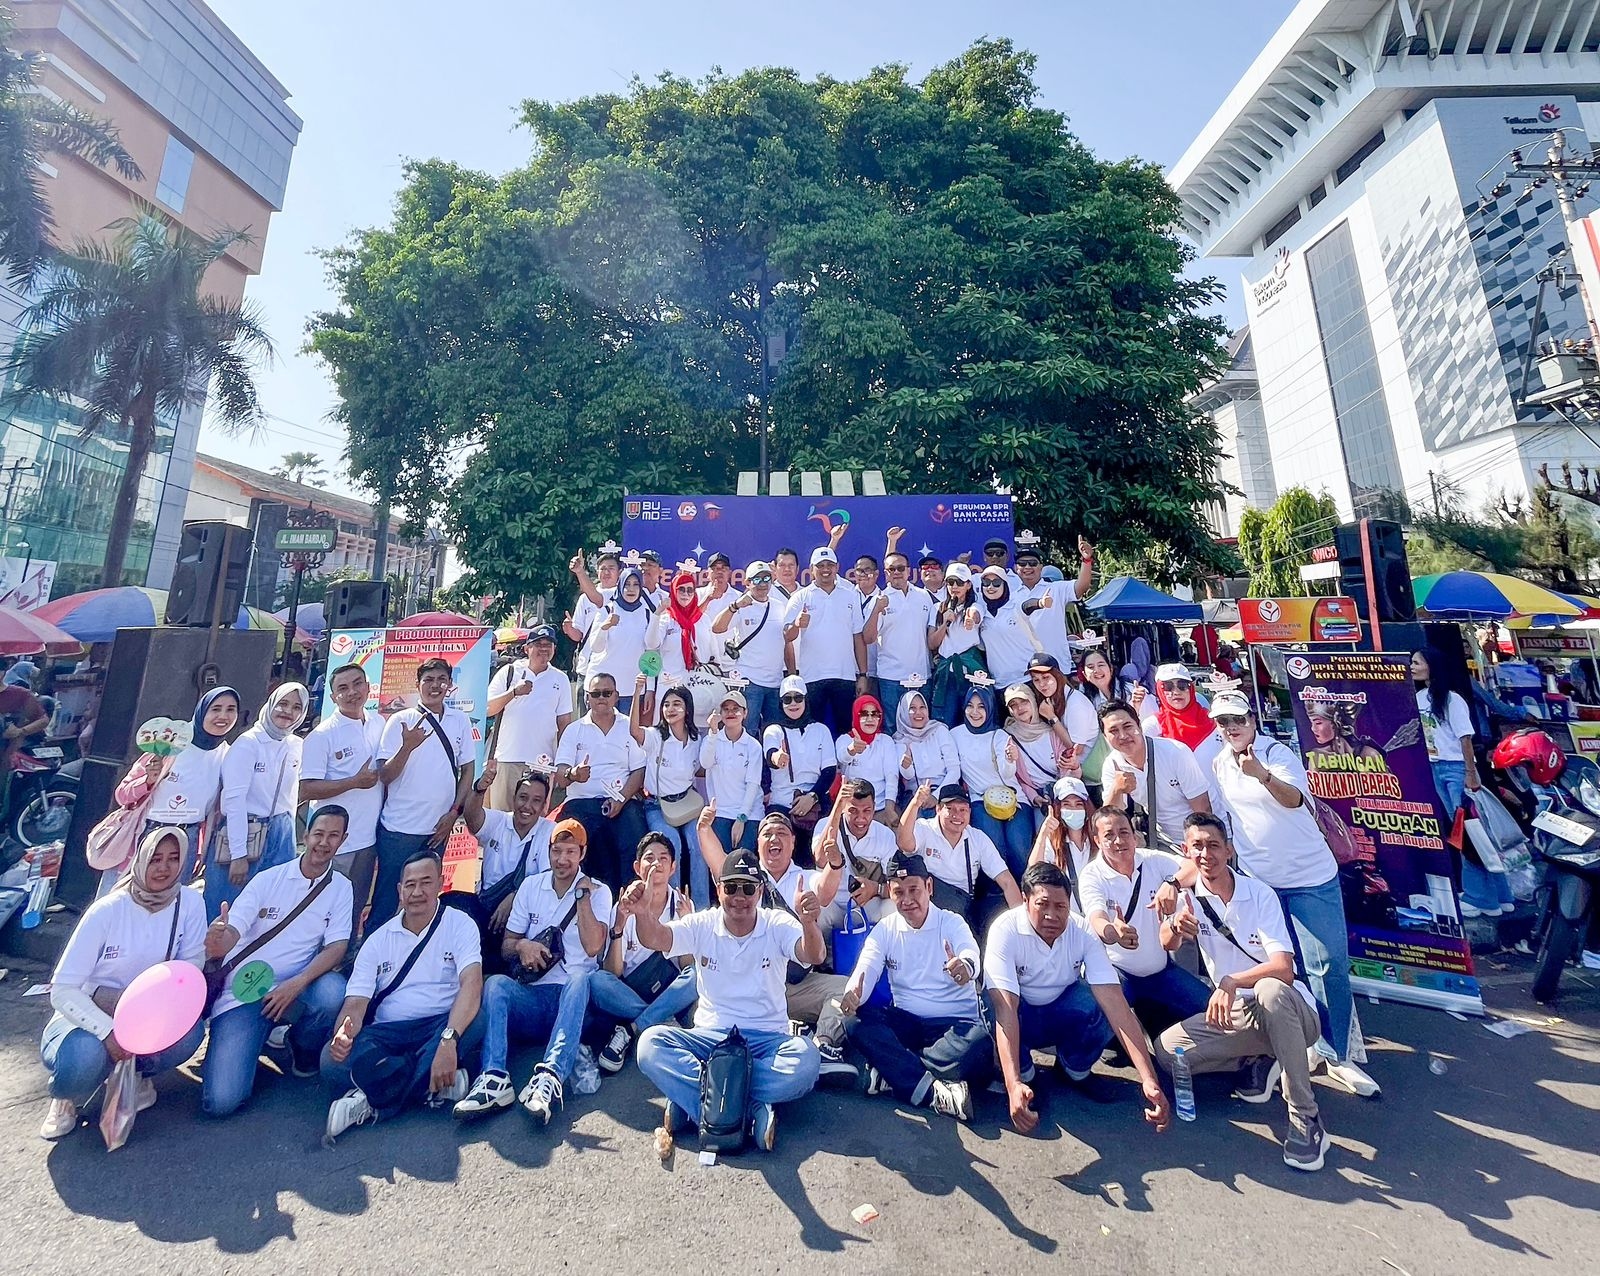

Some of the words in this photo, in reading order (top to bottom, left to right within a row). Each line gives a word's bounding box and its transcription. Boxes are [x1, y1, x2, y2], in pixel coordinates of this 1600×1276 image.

[1503, 116, 1538, 124] Telkom
[290, 533, 305, 544] IMAM
[395, 629, 441, 640] PRODUK
[442, 627, 482, 639] KREDIT
[1522, 638, 1566, 648] JASMINE
[386, 644, 418, 654] KREDIT
[1330, 655, 1382, 663] Perumda
[1370, 664, 1407, 672] PASAR
[1315, 672, 1343, 680] KOTA
[1346, 672, 1405, 681] SEMARANG
[1305, 751, 1387, 773] TABUNGAN
[1306, 770, 1361, 799] SRIKANDI
[1360, 772, 1402, 800] BAPAS
[1351, 806, 1440, 836] PULUHAN
[1403, 832, 1444, 850] Rupiah
